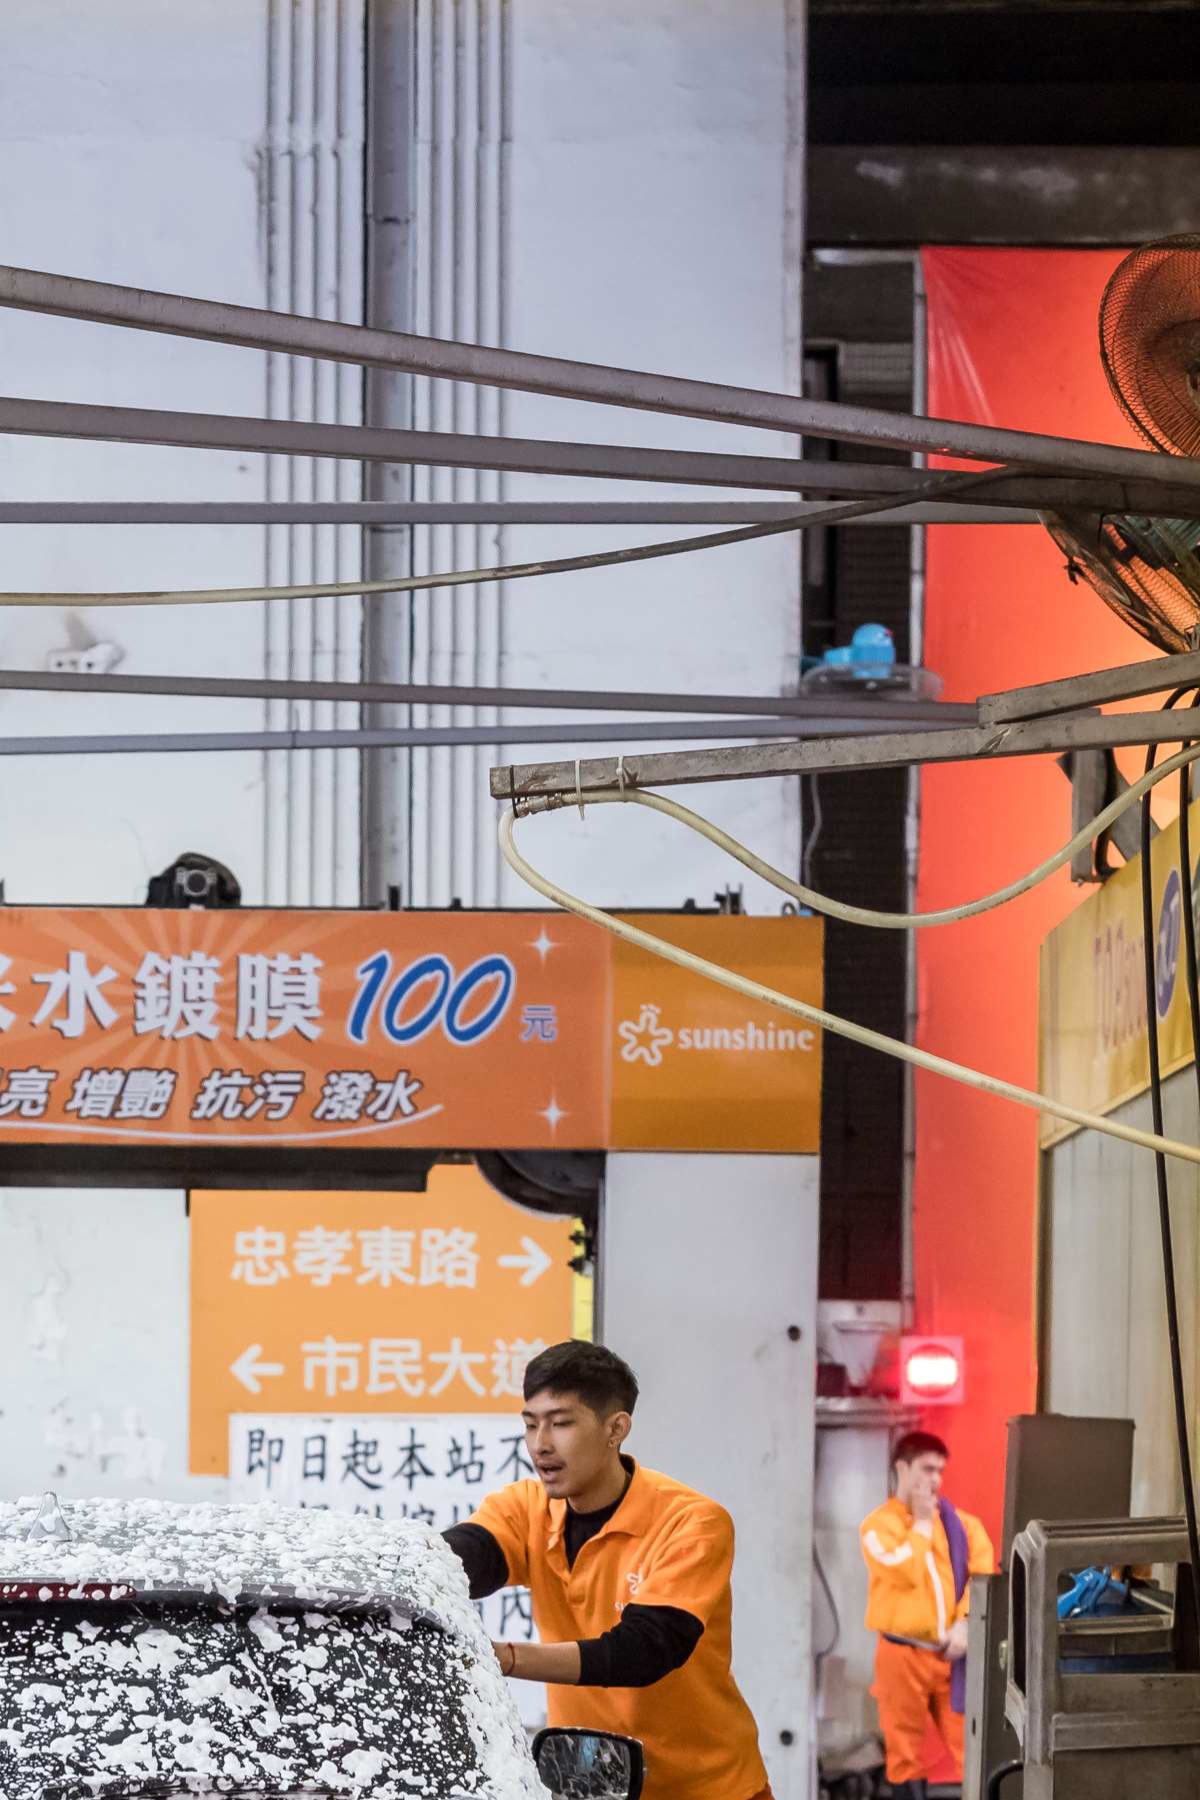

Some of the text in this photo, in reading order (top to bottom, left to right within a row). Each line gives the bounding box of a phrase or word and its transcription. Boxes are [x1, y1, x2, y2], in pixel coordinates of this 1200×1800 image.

[347, 949, 515, 1047] 100
[520, 1004, 558, 1042] 元
[676, 1020, 814, 1053] sunshine
[191, 1068, 305, 1121] 抗污
[311, 1070, 425, 1122] 潑水
[230, 1226, 480, 1289] 忠孝東路
[245, 1427, 535, 1491] 即日起本站不
